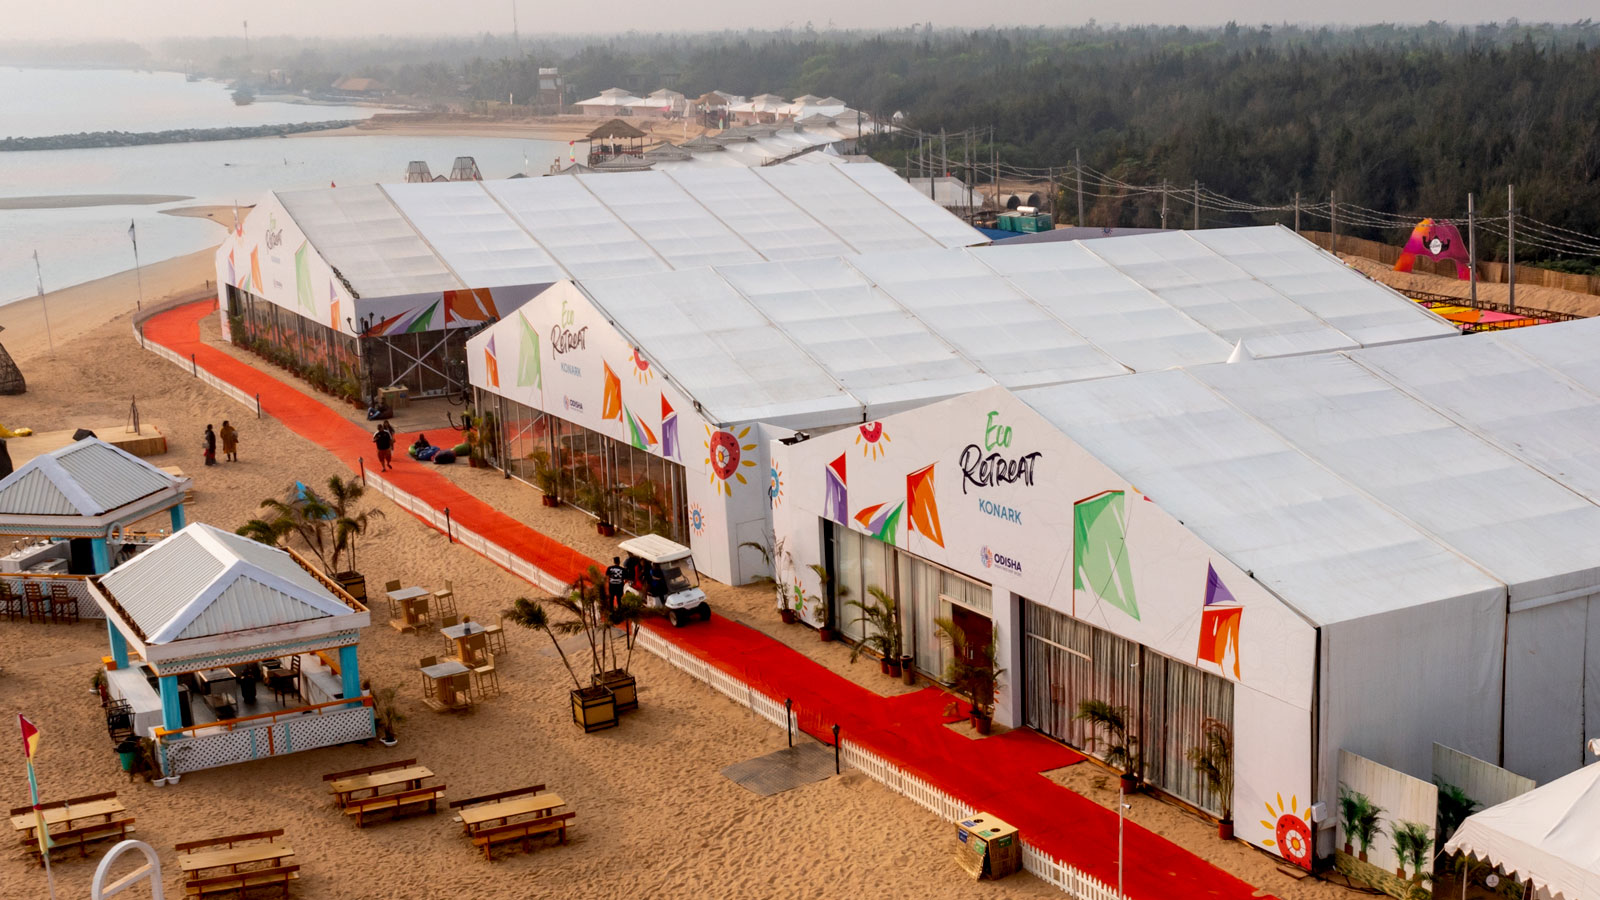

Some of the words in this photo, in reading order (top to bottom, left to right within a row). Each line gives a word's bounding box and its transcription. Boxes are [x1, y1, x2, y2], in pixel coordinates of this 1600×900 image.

[561, 300, 574, 329] Eco
[560, 362, 582, 378] KONARK
[569, 399, 583, 410] ODISHA
[985, 410, 1012, 452] Eco
[978, 498, 1022, 526] KONARK
[994, 553, 1022, 572] ODISHA
